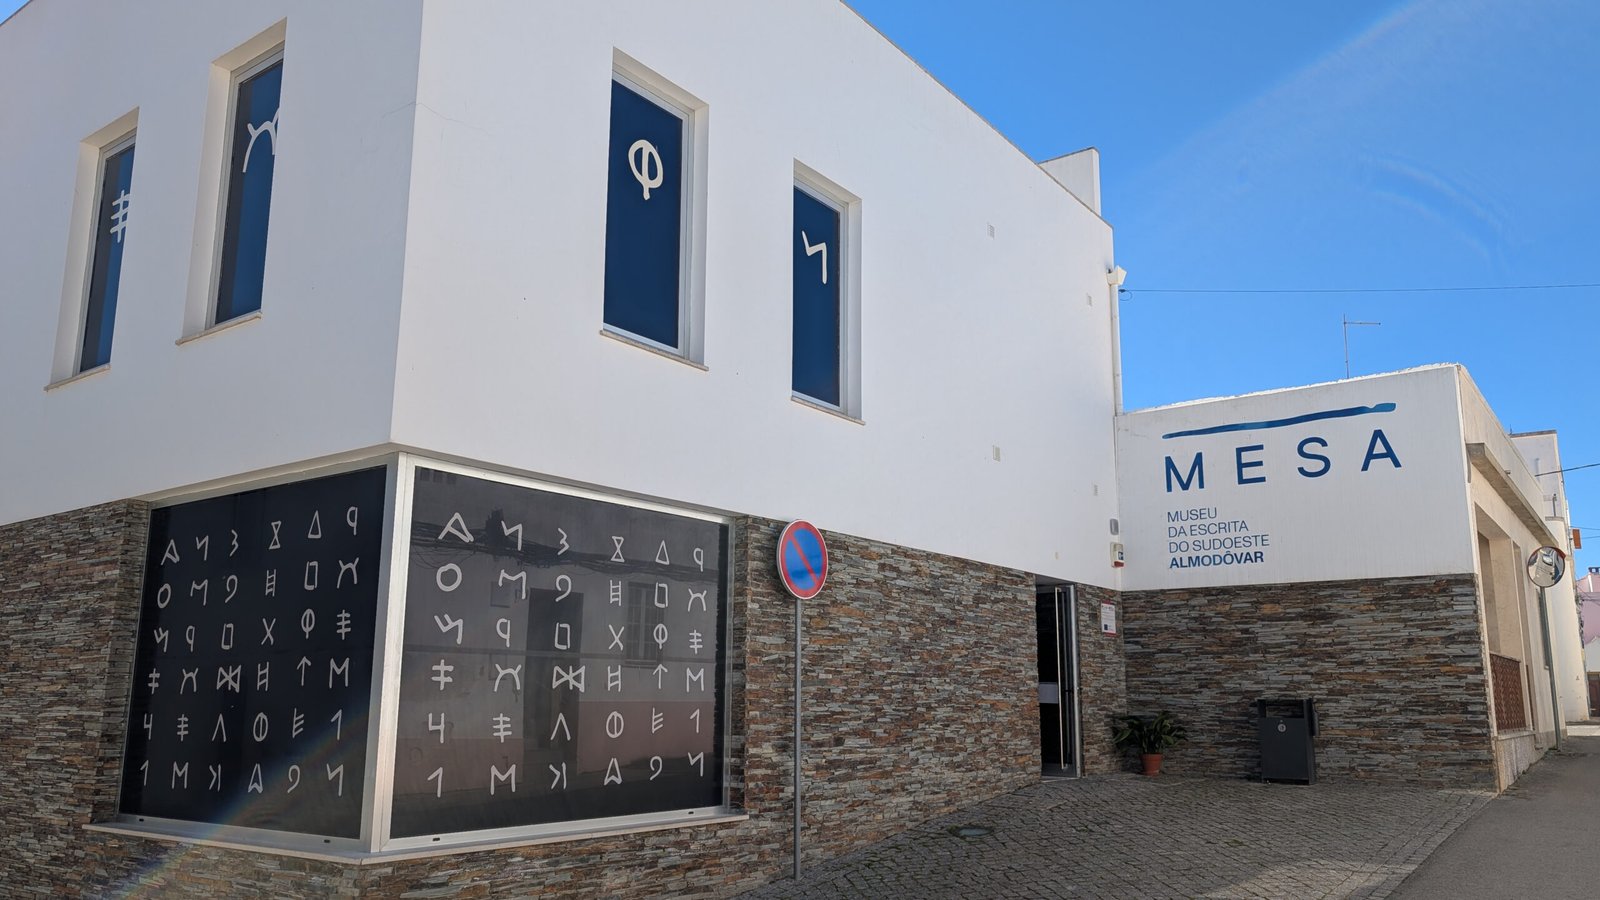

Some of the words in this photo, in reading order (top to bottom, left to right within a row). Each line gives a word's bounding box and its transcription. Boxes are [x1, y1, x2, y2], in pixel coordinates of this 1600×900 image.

[1164, 428, 1402, 493] MESA
[1167, 507, 1217, 523] MUSEU
[1168, 526, 1188, 538] DA
[1189, 520, 1249, 537] ESCRITA
[1169, 541, 1189, 553] DO
[1192, 534, 1270, 552] SUDOESTE
[1169, 550, 1264, 568] ALMODÔVAR
